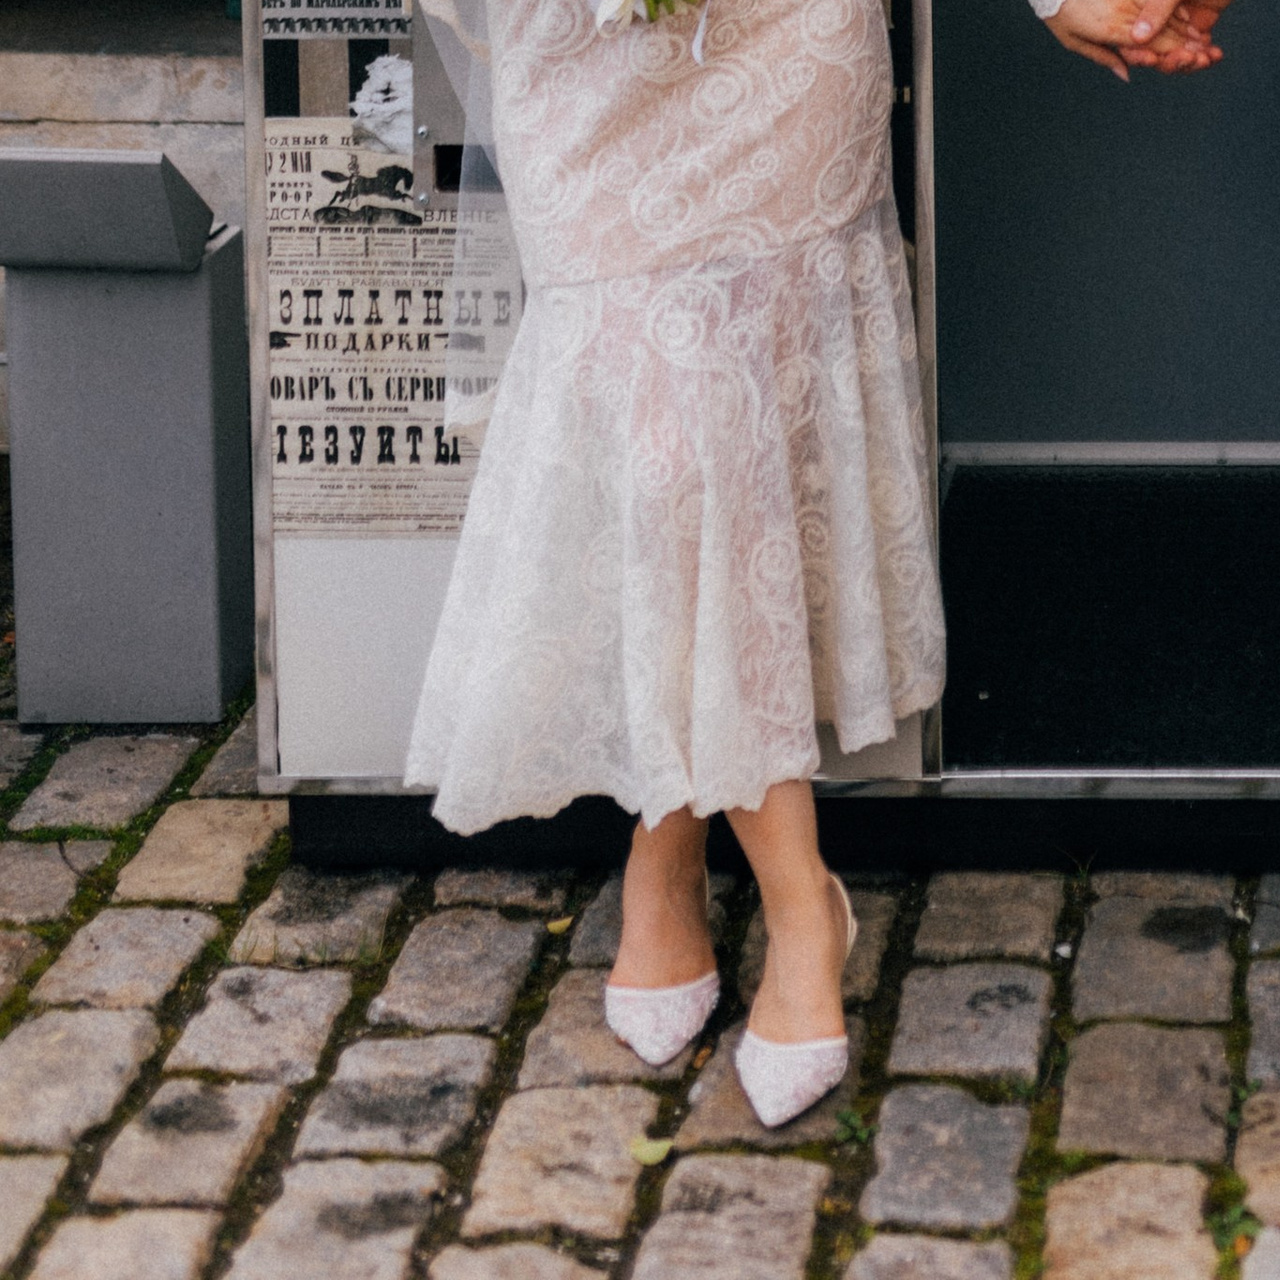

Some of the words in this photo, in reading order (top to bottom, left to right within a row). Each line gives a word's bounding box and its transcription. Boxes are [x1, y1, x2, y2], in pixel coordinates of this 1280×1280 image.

[264, 133, 329, 148] ОДНЫЙ
[264, 207, 312, 221] ДСТА
[305, 332, 431, 355] ПОДАРКИ
[348, 375, 374, 402] СЪ
